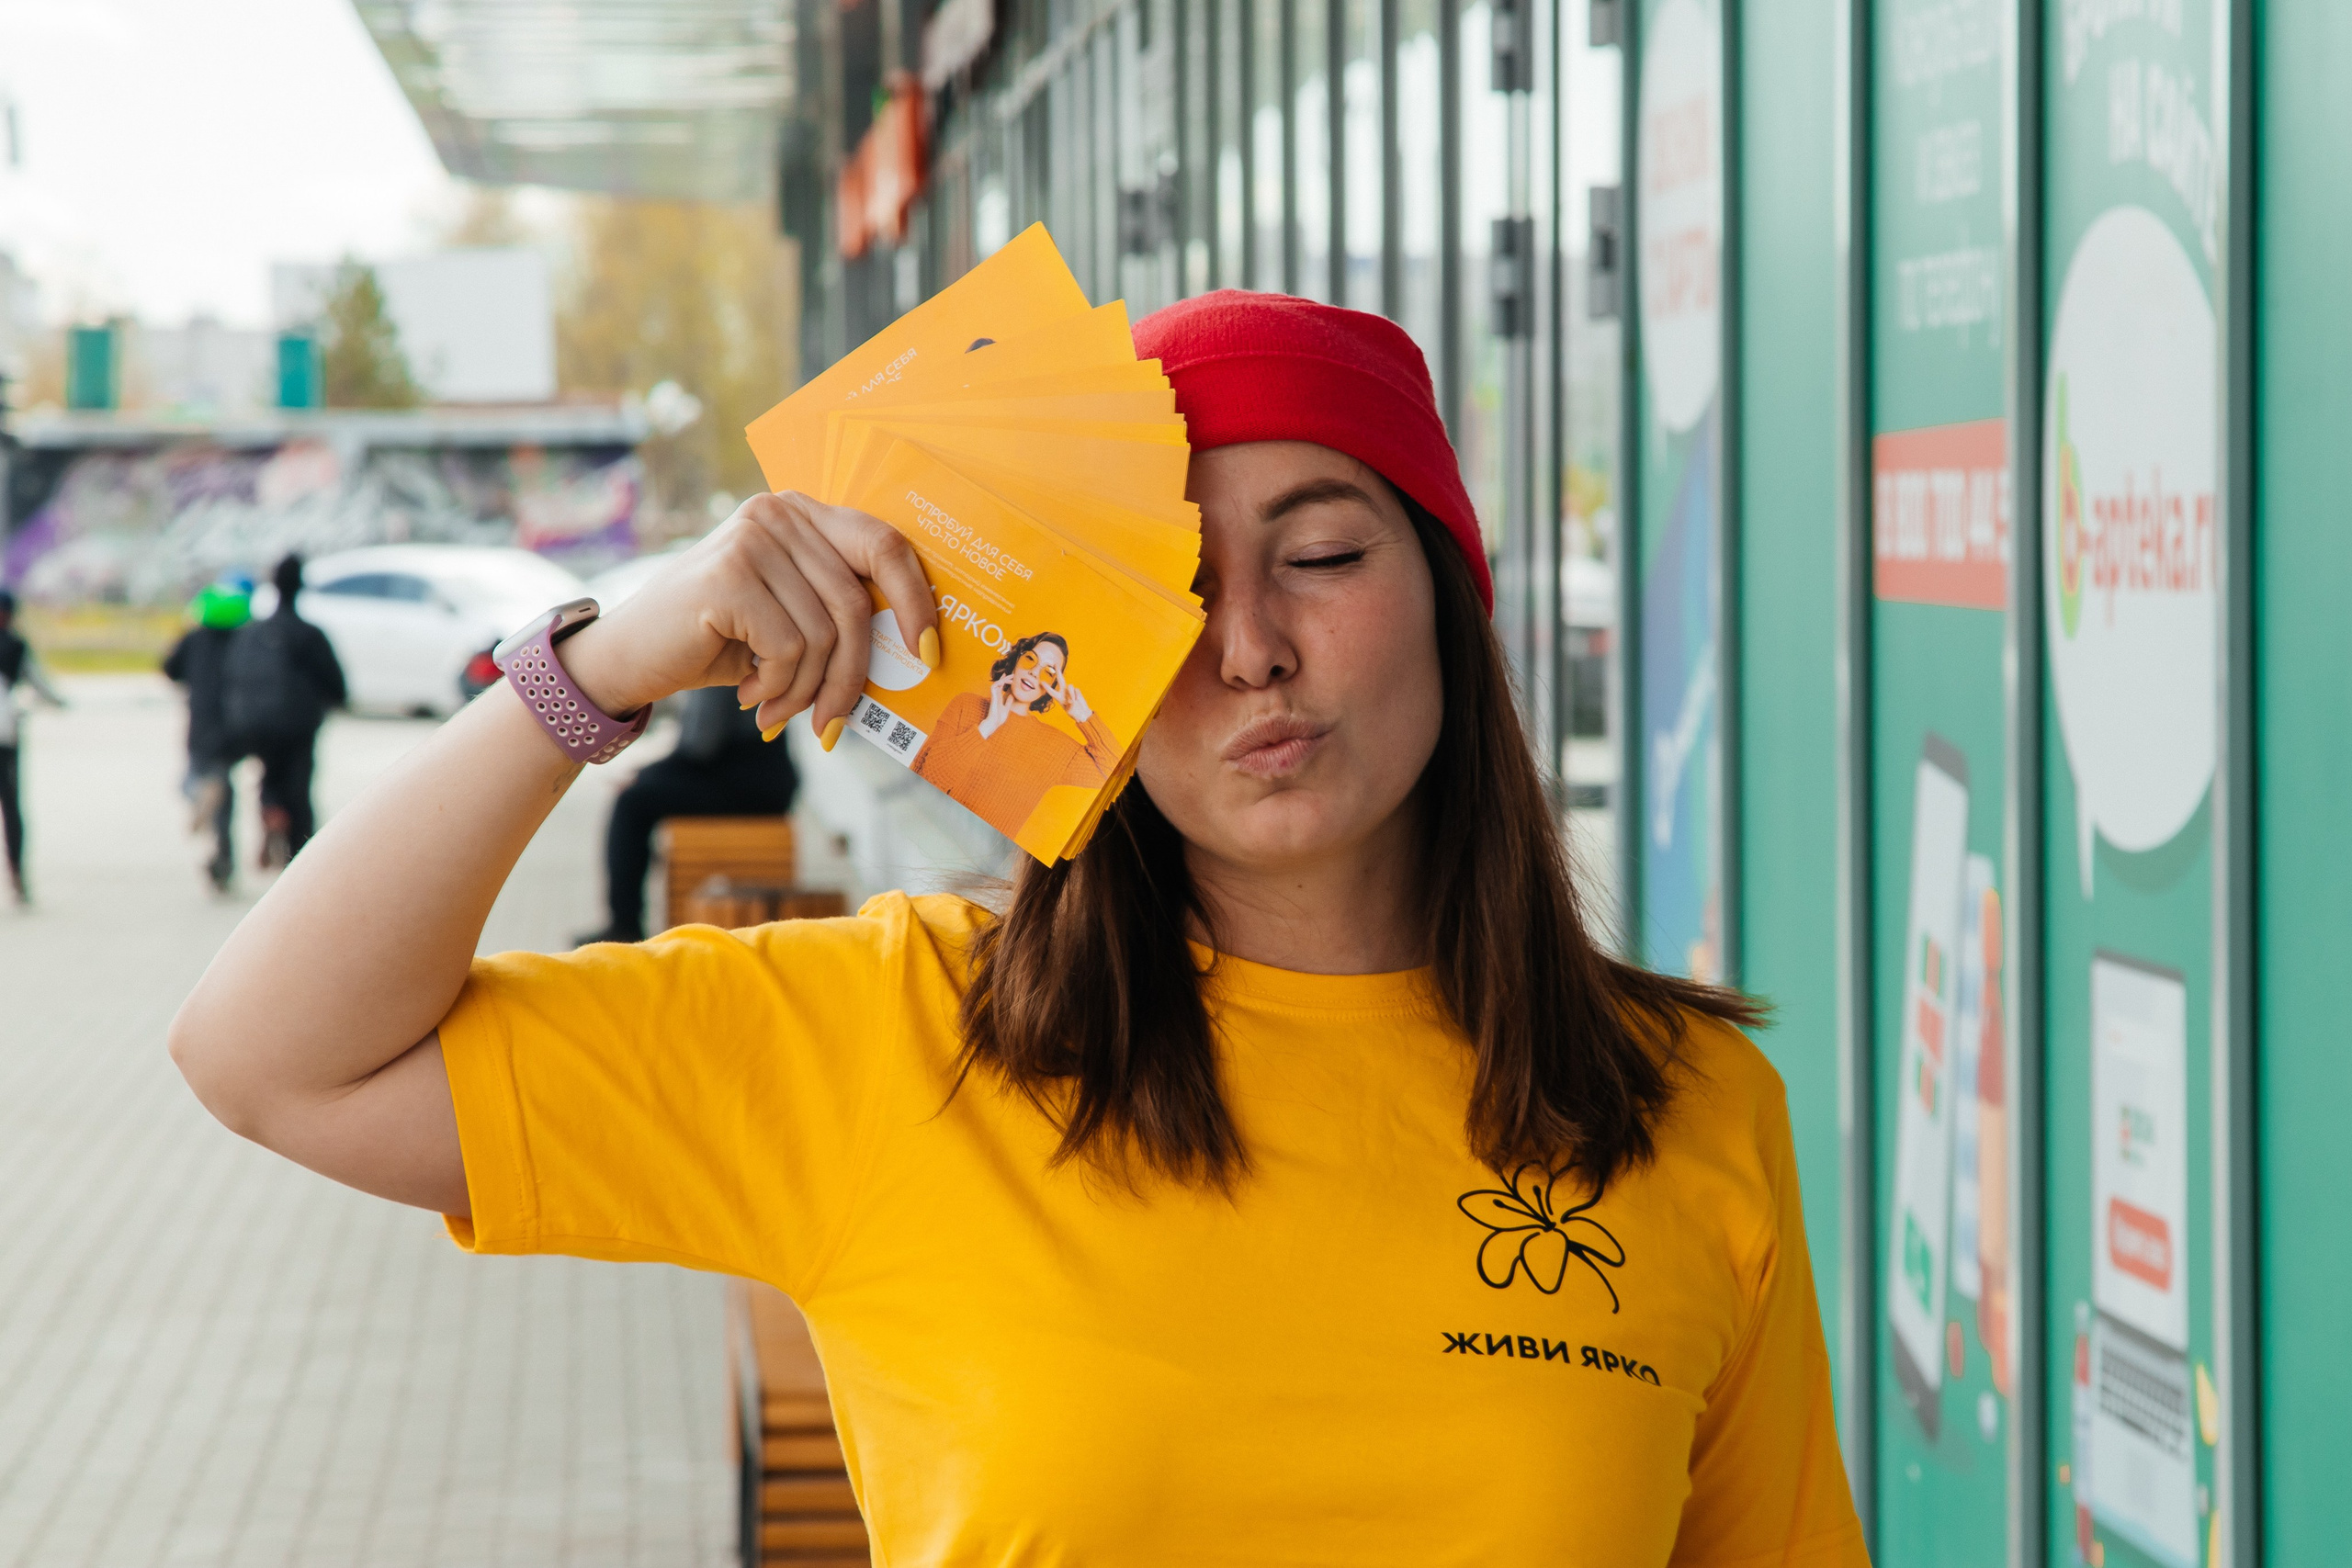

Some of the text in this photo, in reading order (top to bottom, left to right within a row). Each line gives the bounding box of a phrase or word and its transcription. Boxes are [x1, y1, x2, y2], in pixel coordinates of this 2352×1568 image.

[885, 347, 918, 376] СЕБЯ
[905, 491, 973, 541] ПОПРОБУЙ
[970, 537, 1000, 558] ДЛЯ
[999, 554, 1033, 581] СЕБЯ
[917, 514, 959, 549] ЧТО-ТО
[959, 545, 1007, 581] НОВОЕ
[870, 627, 892, 644] СТАРТ
[936, 594, 1012, 656] ЯРКО»
[869, 635, 923, 676] ОТОКА ПРОЕКТА
[1440, 1332, 1662, 1387] ЖИВИ ЯРКО
